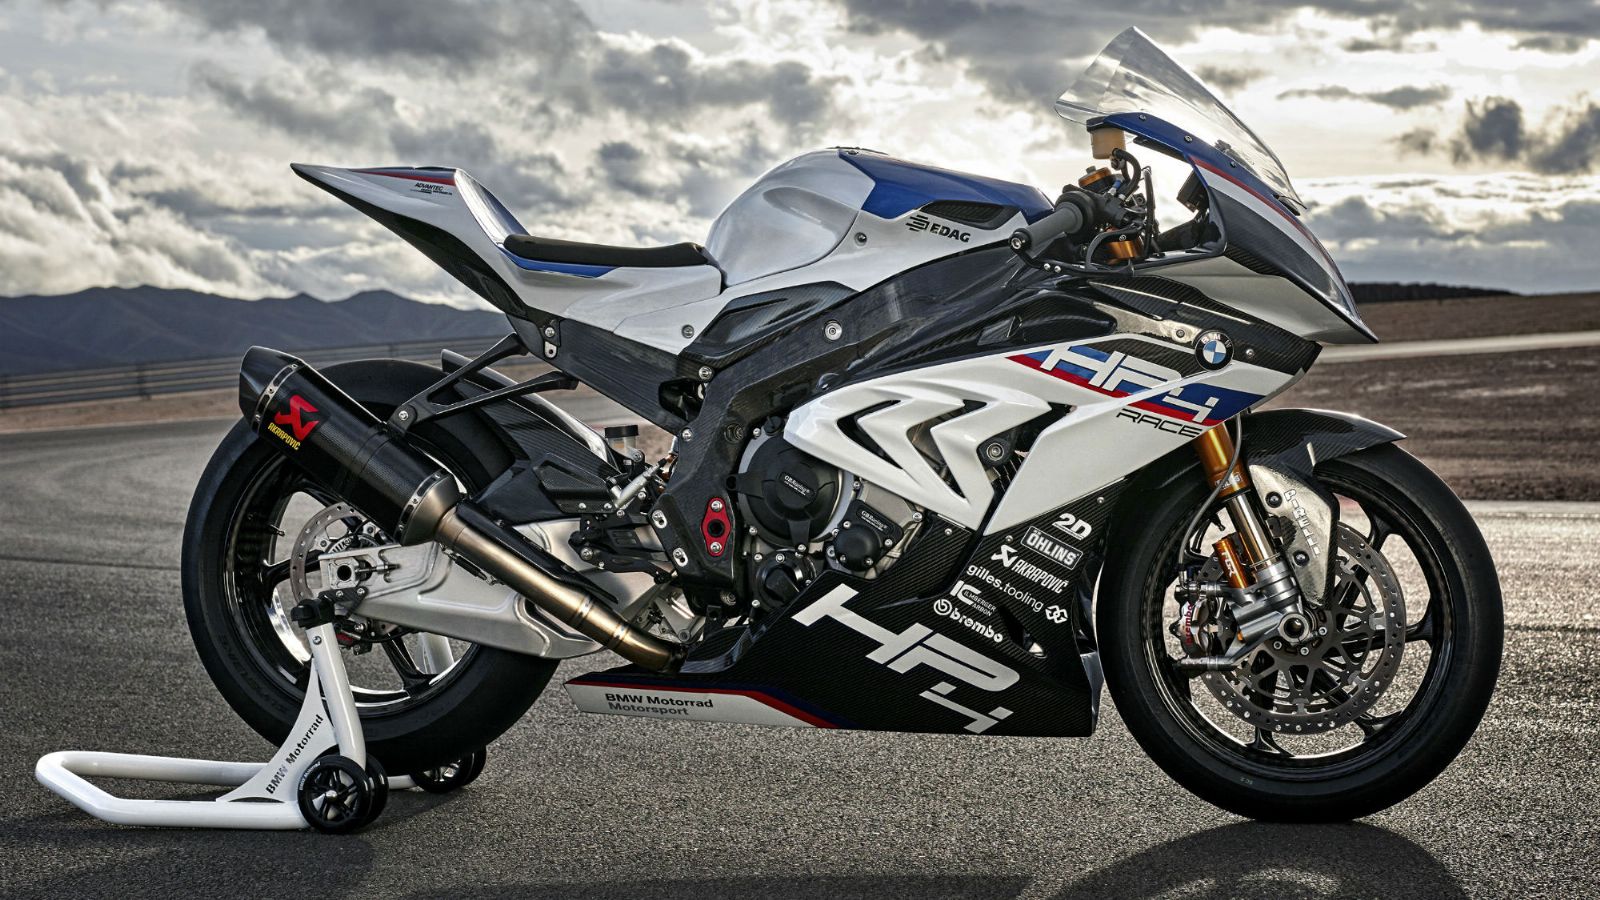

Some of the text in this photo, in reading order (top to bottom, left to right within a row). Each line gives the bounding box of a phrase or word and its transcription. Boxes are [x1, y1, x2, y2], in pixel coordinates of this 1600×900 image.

[930, 223, 971, 242] EDAG
[1116, 408, 1202, 437] RACE
[1052, 512, 1092, 541] 2D
[1026, 529, 1077, 566] ÖHLINS
[966, 564, 1044, 613] gilles.tooling
[950, 607, 1004, 643] brembo
[605, 693, 714, 708] BMW Motorrad
[609, 703, 689, 716] Motorsport
[265, 763, 289, 795] BMW
[285, 714, 324, 765] Motorrad
